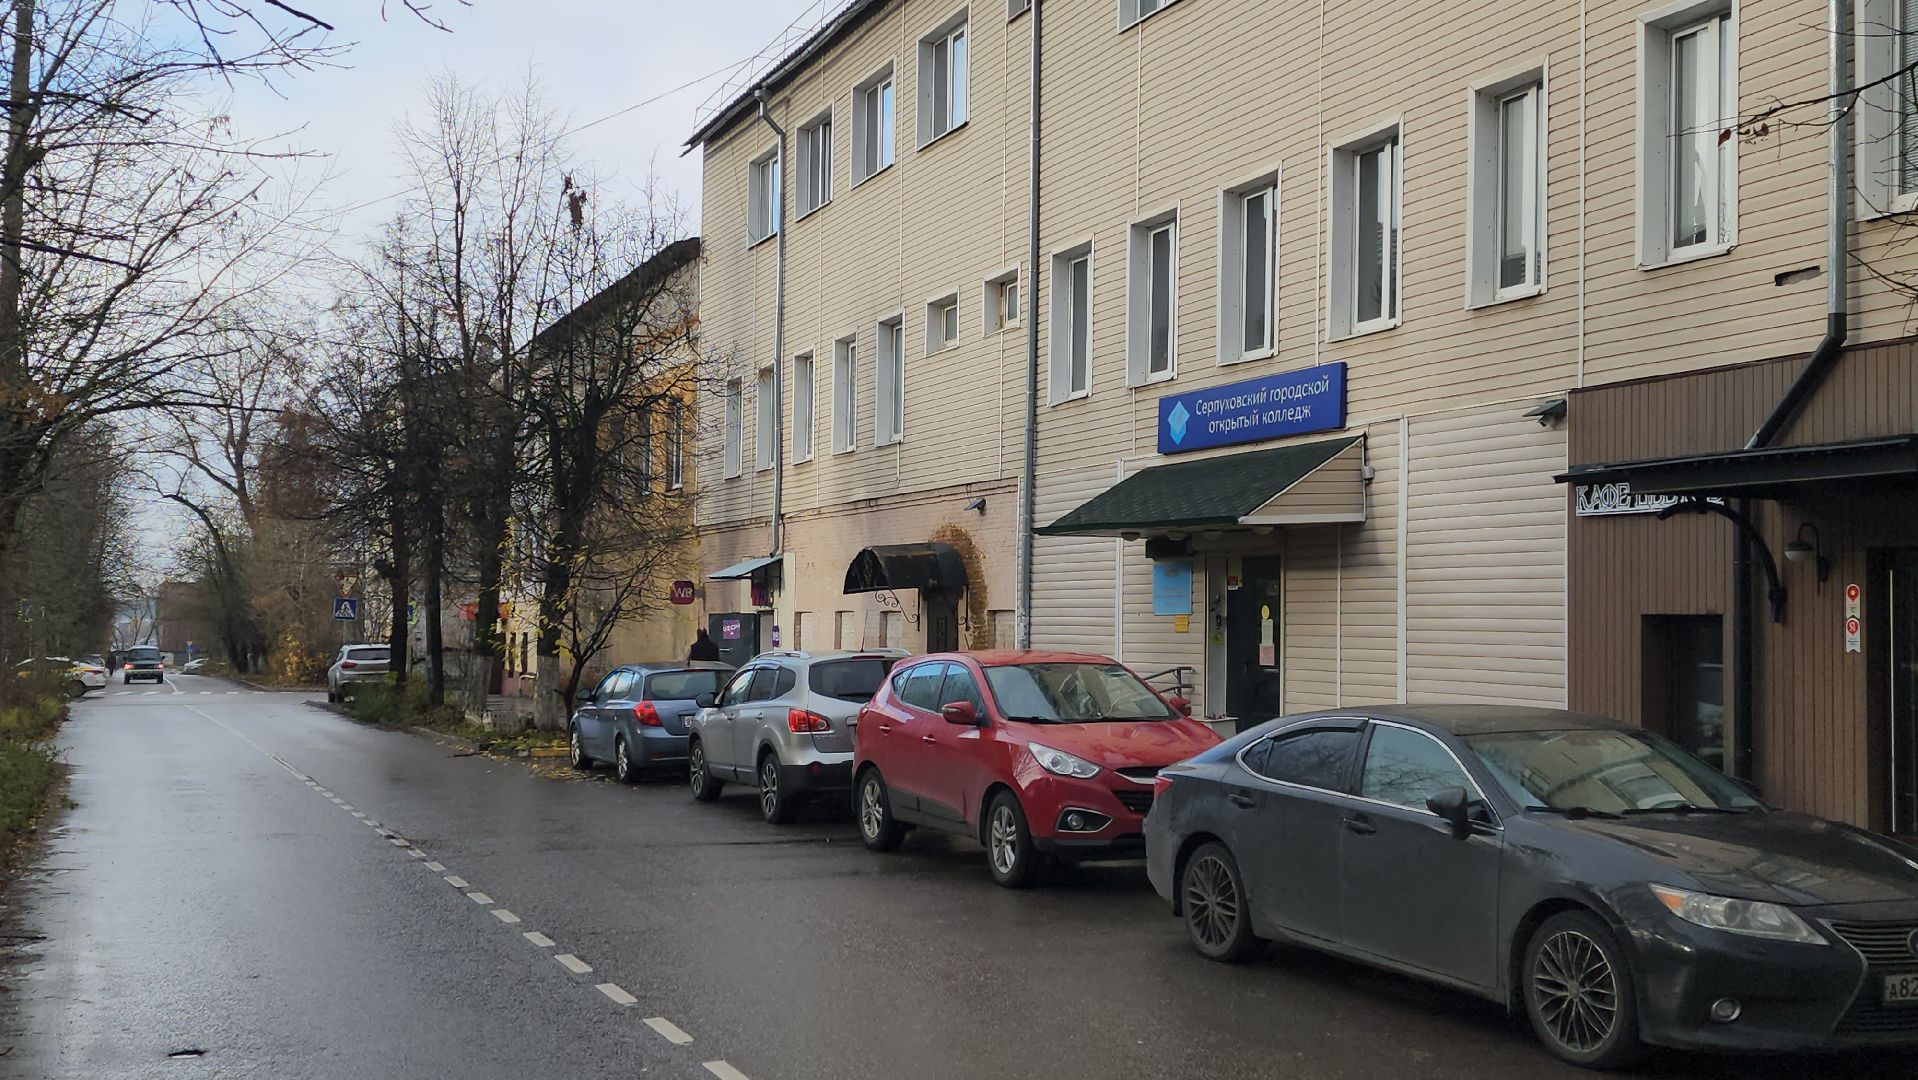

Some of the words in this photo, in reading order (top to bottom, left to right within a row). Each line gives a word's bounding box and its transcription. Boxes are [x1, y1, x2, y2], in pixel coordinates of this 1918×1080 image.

[1195, 387, 1267, 417] Серпуховский
[1269, 375, 1329, 403] городской
[1208, 410, 1260, 435] открытый
[1262, 404, 1311, 423] колледж
[1575, 482, 1631, 511] КАФЕ
[674, 587, 693, 598] WB
